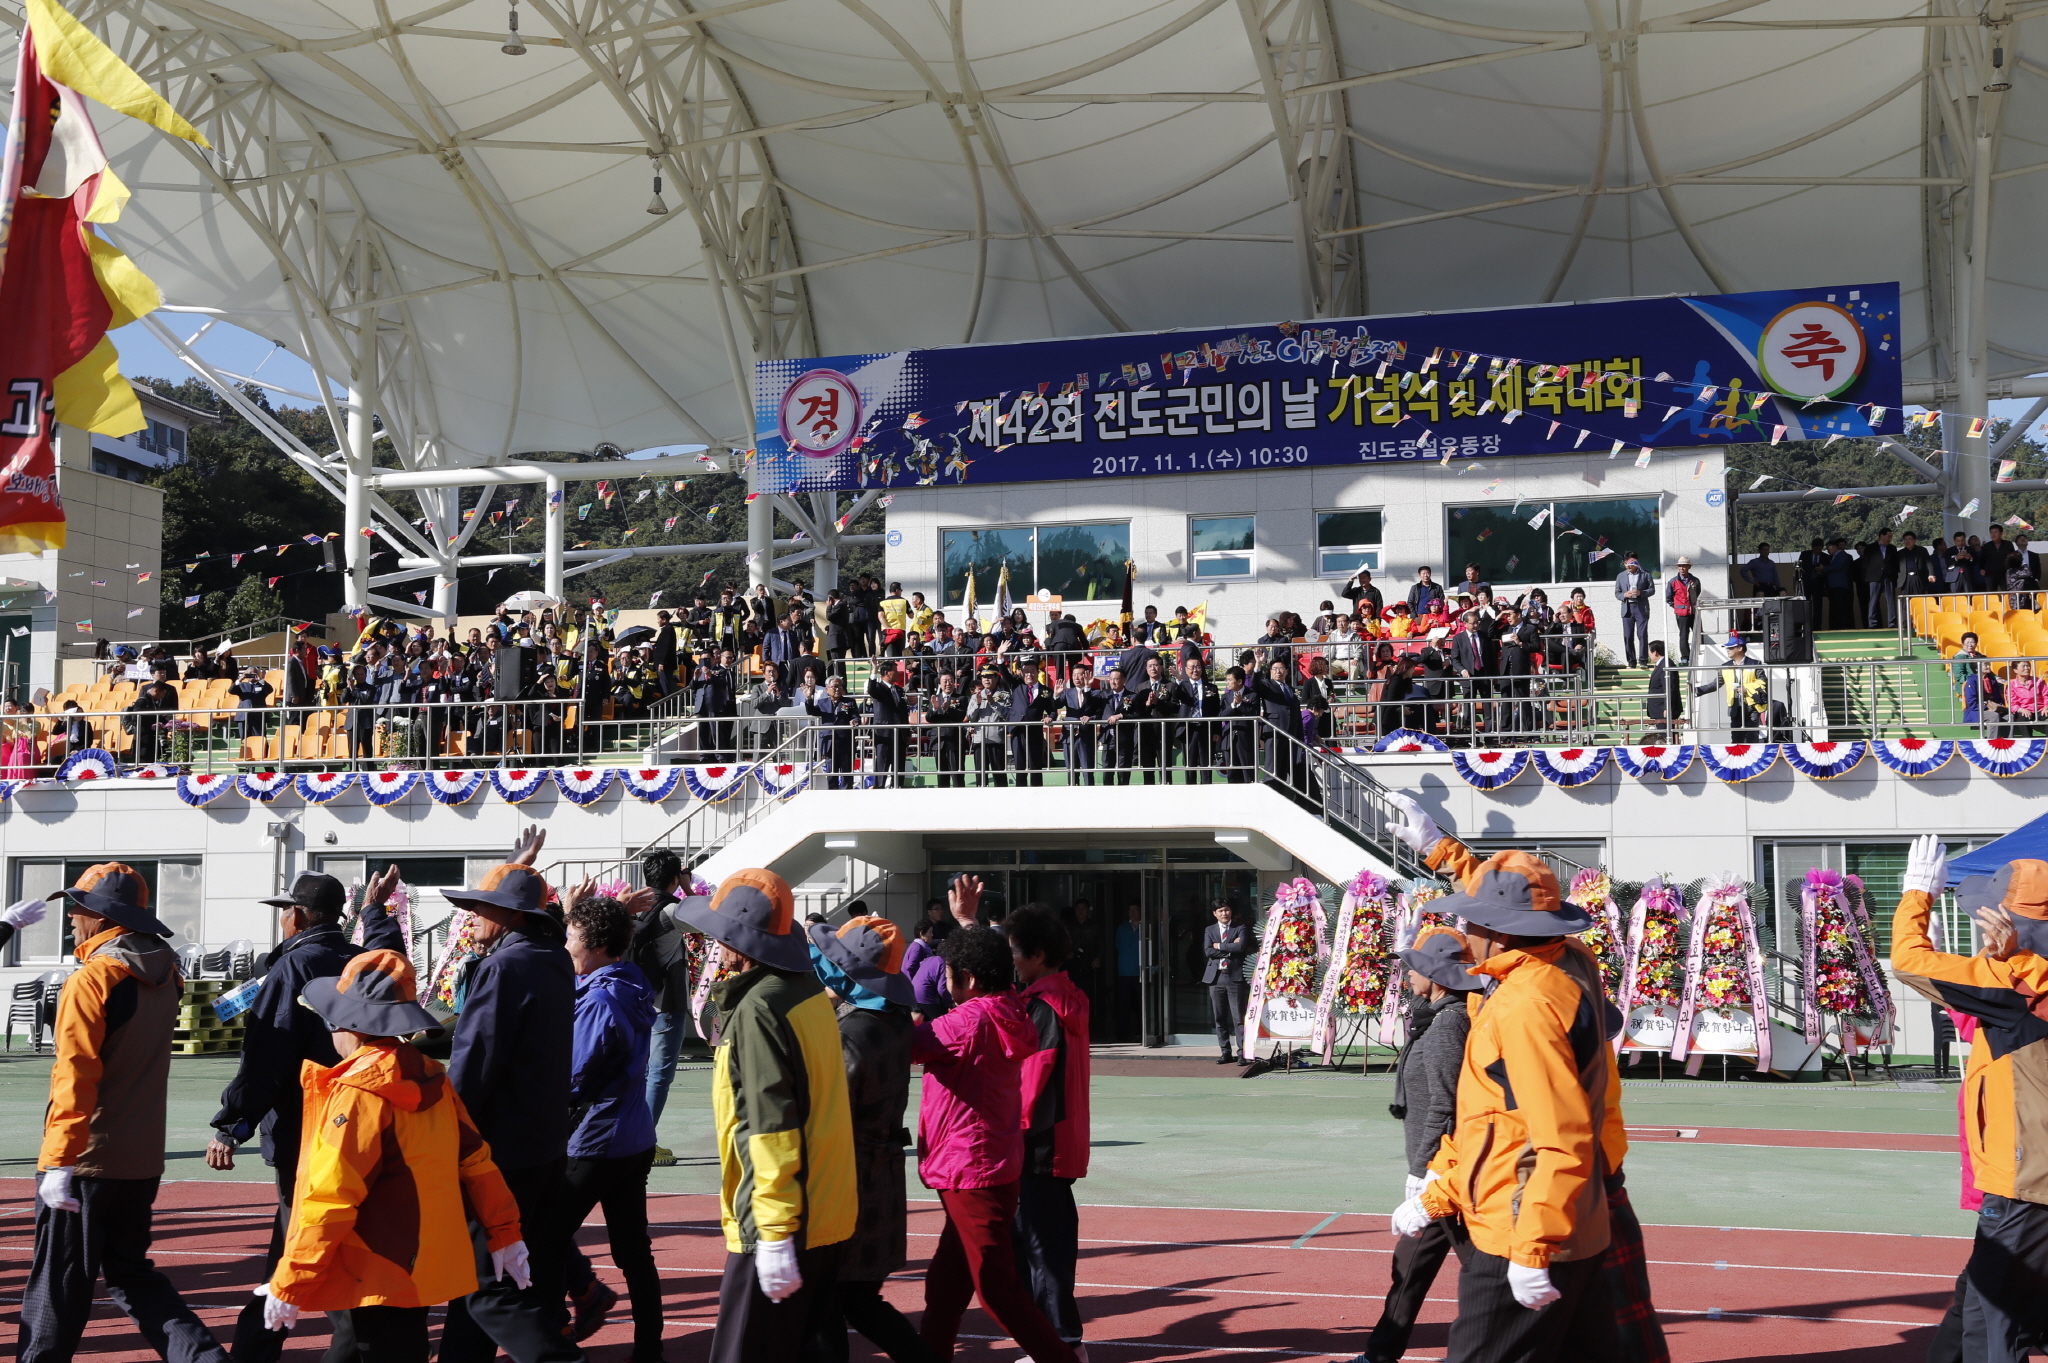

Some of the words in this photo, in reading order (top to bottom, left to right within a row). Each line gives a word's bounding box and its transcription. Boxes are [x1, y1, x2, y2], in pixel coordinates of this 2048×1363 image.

[1781, 323, 1847, 381] 축
[797, 388, 839, 446] 경
[968, 393, 1082, 447] 제42회
[1094, 382, 1271, 440] 진도군민의
[1283, 378, 1318, 428] 날
[1327, 372, 1439, 426] 기념식
[1450, 380, 1476, 418] 및
[1487, 356, 1641, 416] 체육대회
[1093, 456, 1146, 475] 2017.
[1155, 454, 1181, 472] 11.
[1249, 446, 1308, 466] 10:30
[1359, 434, 1501, 461] 진도공설운동장
